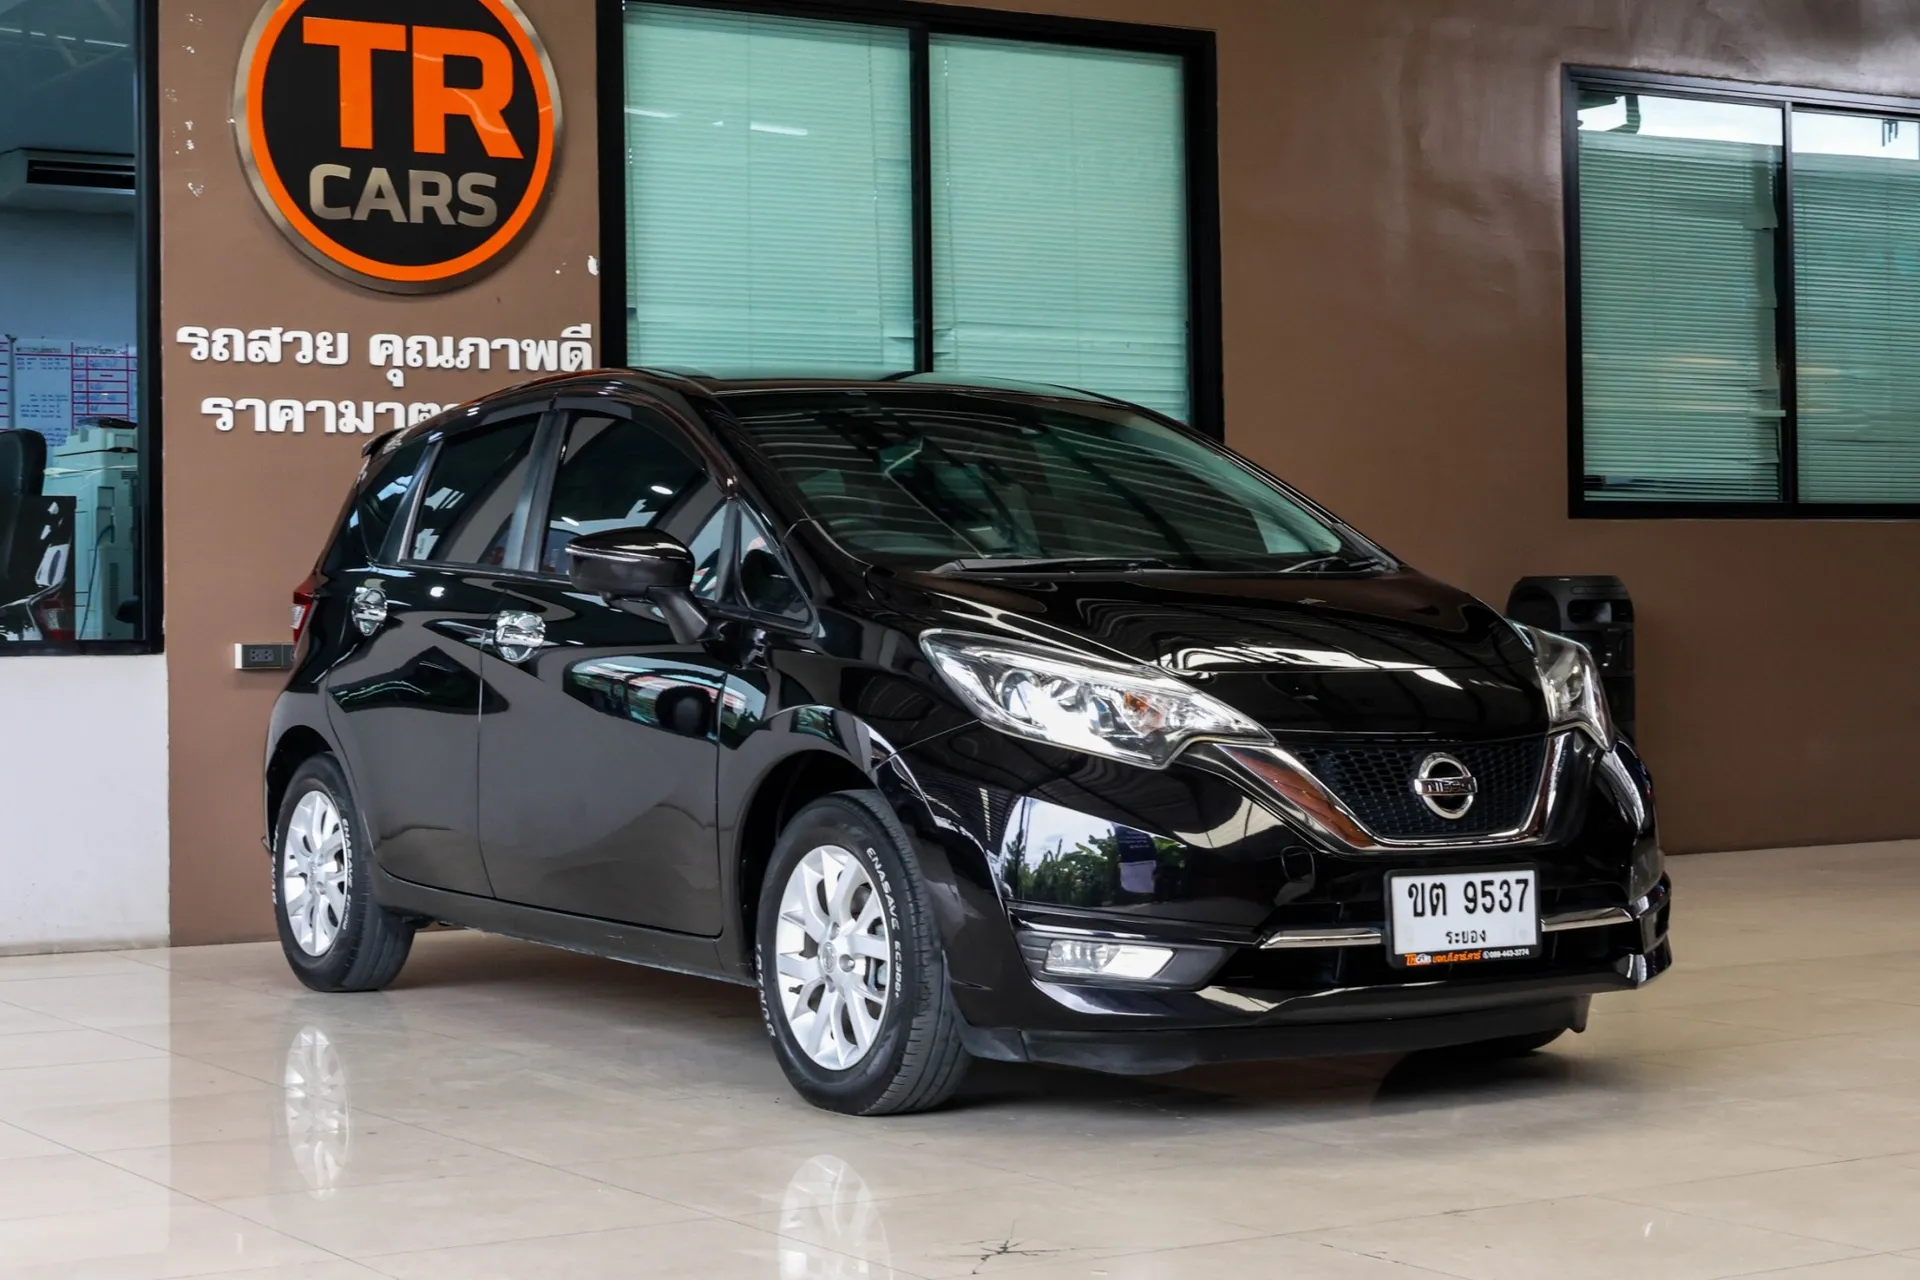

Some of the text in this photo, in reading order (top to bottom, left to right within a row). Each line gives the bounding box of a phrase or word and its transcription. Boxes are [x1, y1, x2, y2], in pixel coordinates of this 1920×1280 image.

[303, 16, 524, 159] TR
[309, 164, 497, 228] CARS
[176, 323, 592, 387] รถสวย คุณภาพดี
[201, 397, 460, 434] ราคามาต
[866, 847, 900, 931] ENASAVE
[1407, 878, 1530, 918] ขต 9537
[1445, 929, 1487, 945] ระยอง
